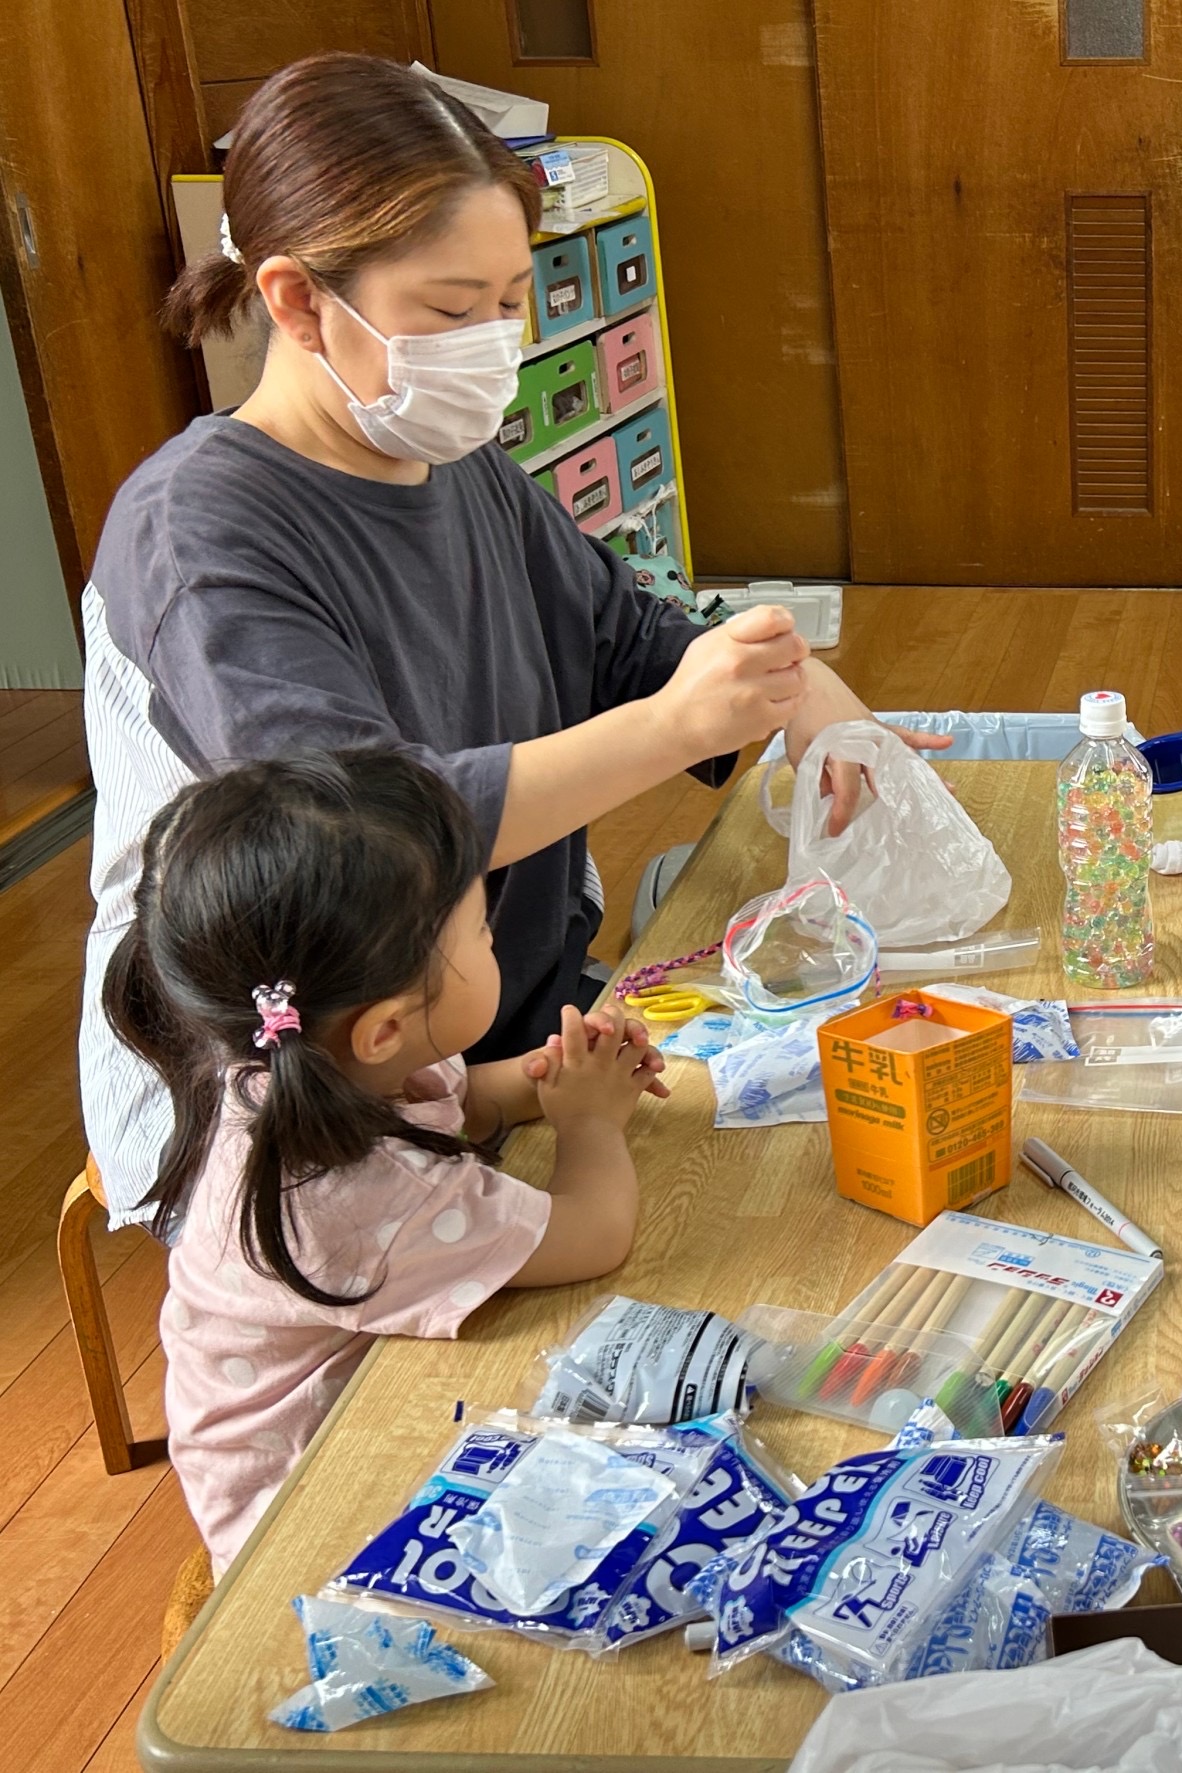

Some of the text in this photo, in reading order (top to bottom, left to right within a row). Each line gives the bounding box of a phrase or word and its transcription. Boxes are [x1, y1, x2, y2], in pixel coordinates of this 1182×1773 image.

[831, 1040, 904, 1087] 牛乳
[837, 1106, 905, 1131] morinaga milk
[963, 1456, 992, 1509] Keep cool
[880, 1573, 910, 1610] Sports
